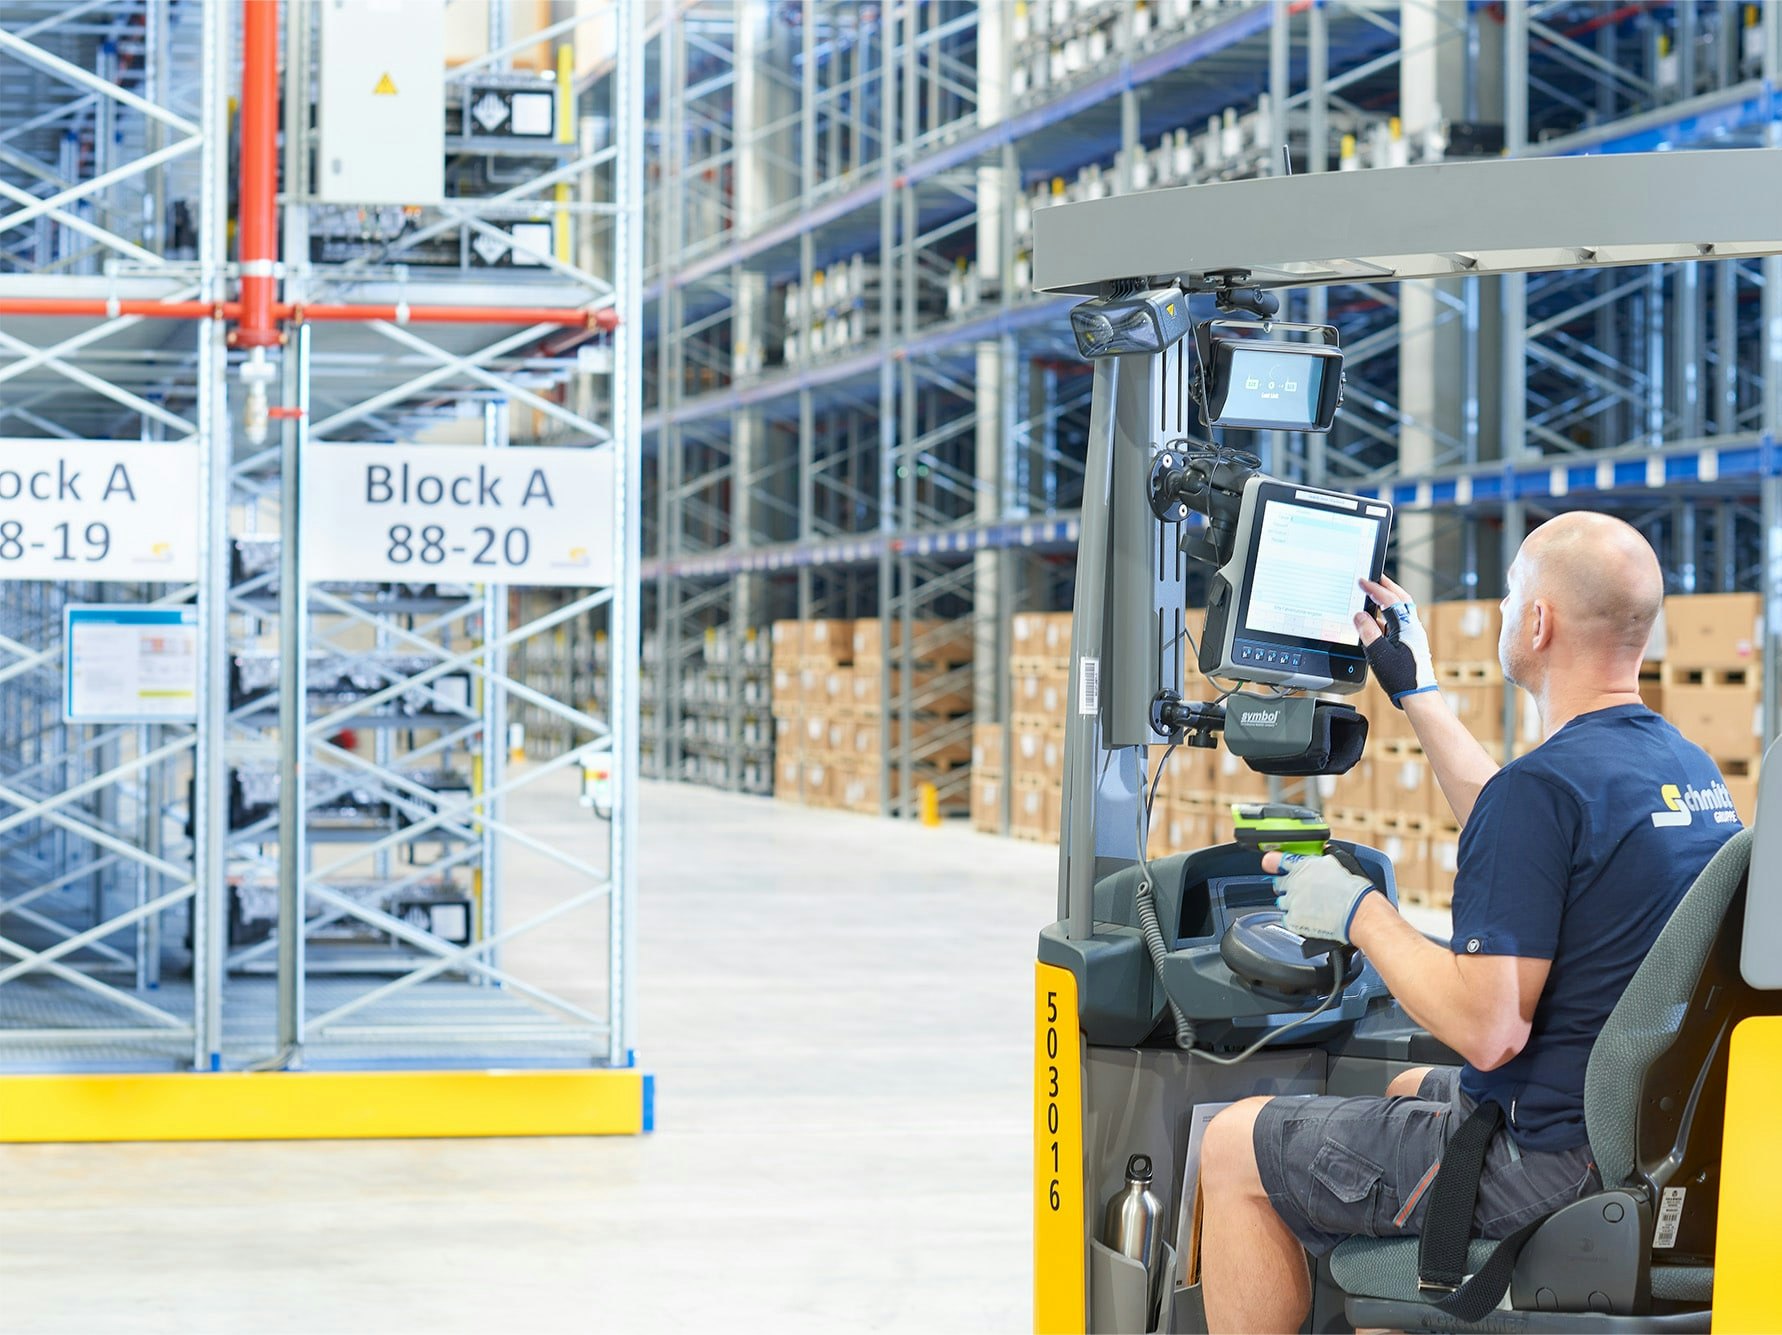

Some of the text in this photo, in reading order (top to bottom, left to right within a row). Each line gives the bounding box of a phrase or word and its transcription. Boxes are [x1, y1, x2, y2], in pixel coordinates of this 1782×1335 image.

[102, 462, 136, 502] A
[366, 462, 555, 508] Block A
[0, 520, 111, 562] 8-19
[387, 523, 531, 567] 88-20
[1240, 709, 1279, 724] symbol
[1046, 991, 1061, 1212] 503016
